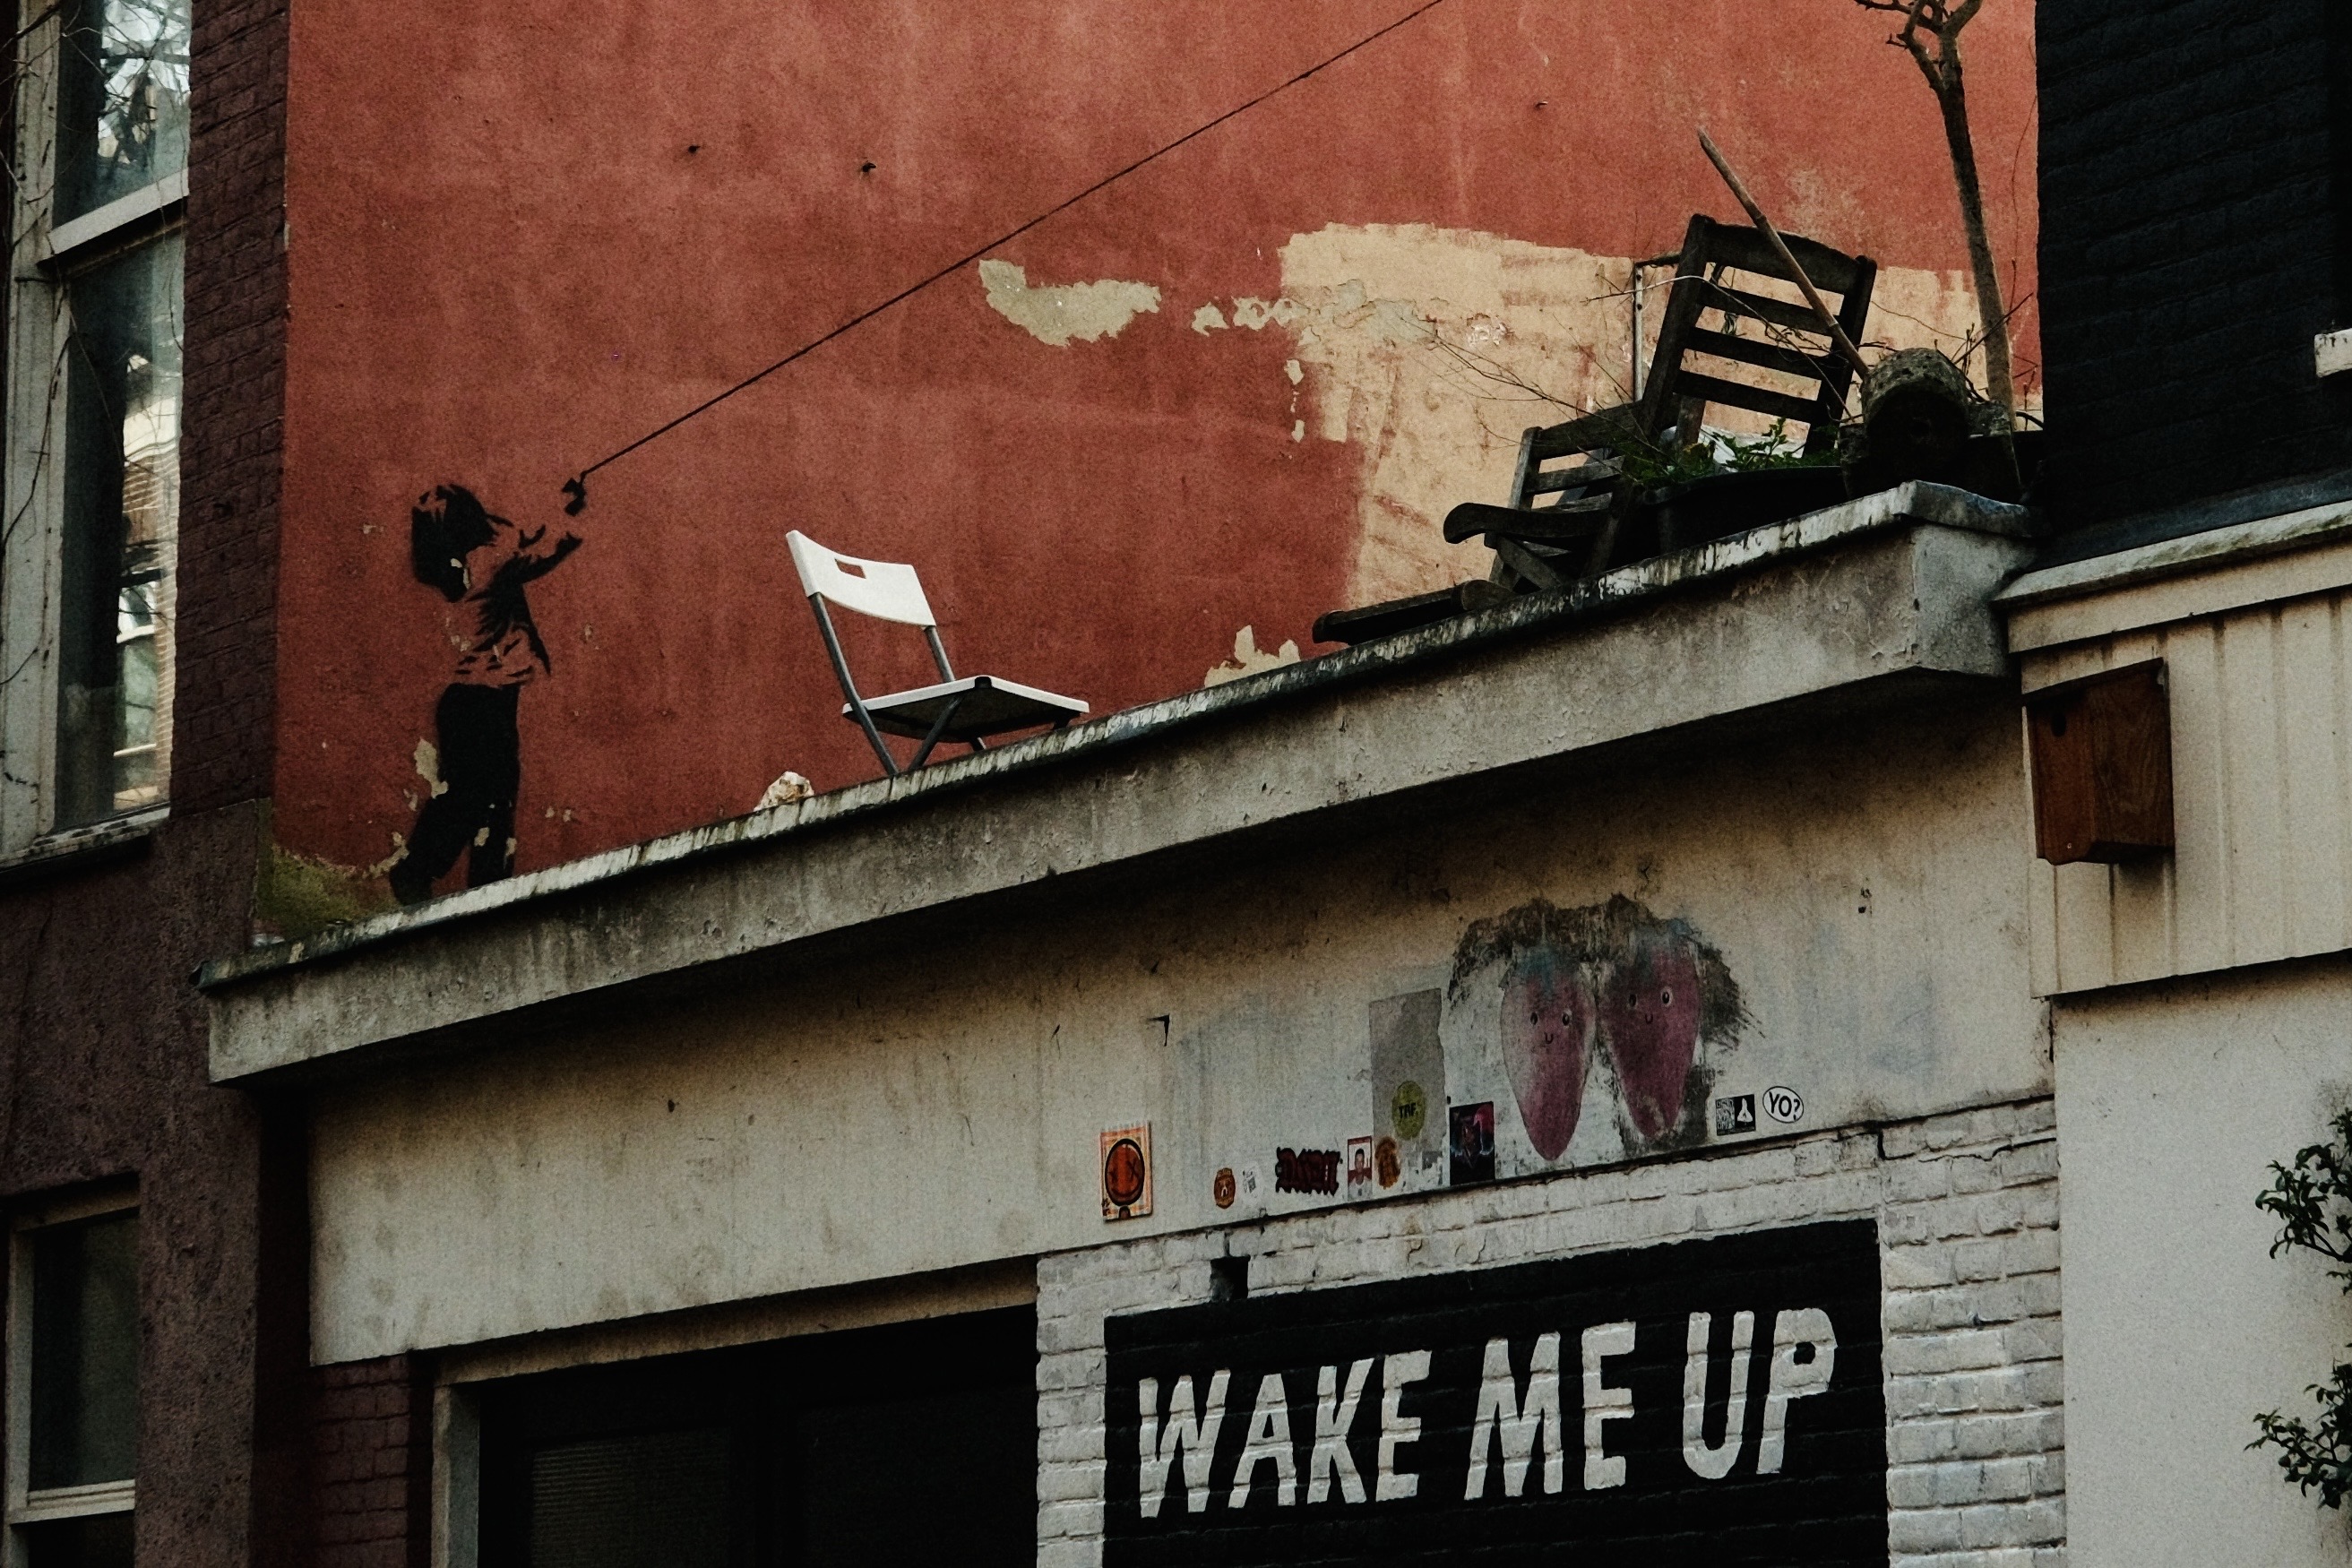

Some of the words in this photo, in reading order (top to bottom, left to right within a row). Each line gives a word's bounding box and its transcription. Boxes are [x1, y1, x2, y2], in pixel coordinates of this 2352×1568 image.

[1769, 1090, 1801, 1122] YO?
[1138, 1349, 1433, 1518] WAKE
[1464, 1321, 1637, 1501] ME
[1682, 1307, 1838, 1480] UP
